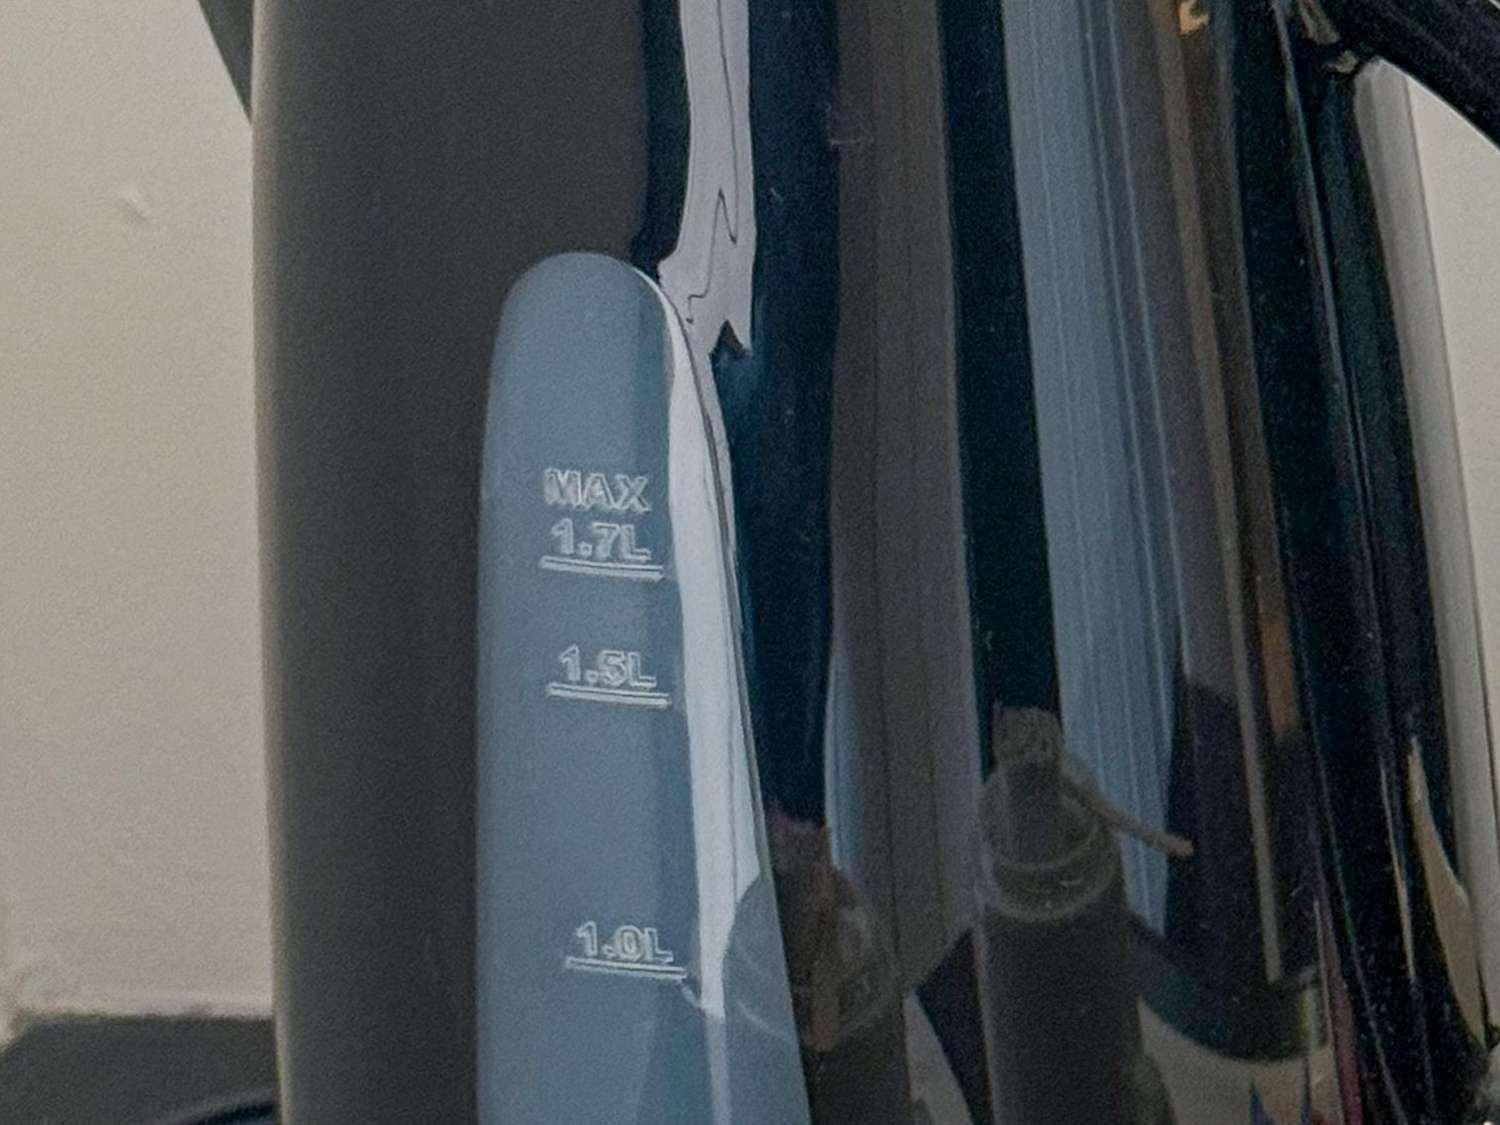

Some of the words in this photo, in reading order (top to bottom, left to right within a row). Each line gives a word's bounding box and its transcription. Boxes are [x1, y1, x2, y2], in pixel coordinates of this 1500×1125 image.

[543, 467, 652, 513] MAX
[550, 517, 652, 561] 1.7L
[557, 643, 657, 690] 1.5L
[574, 922, 674, 965] 1.0L
